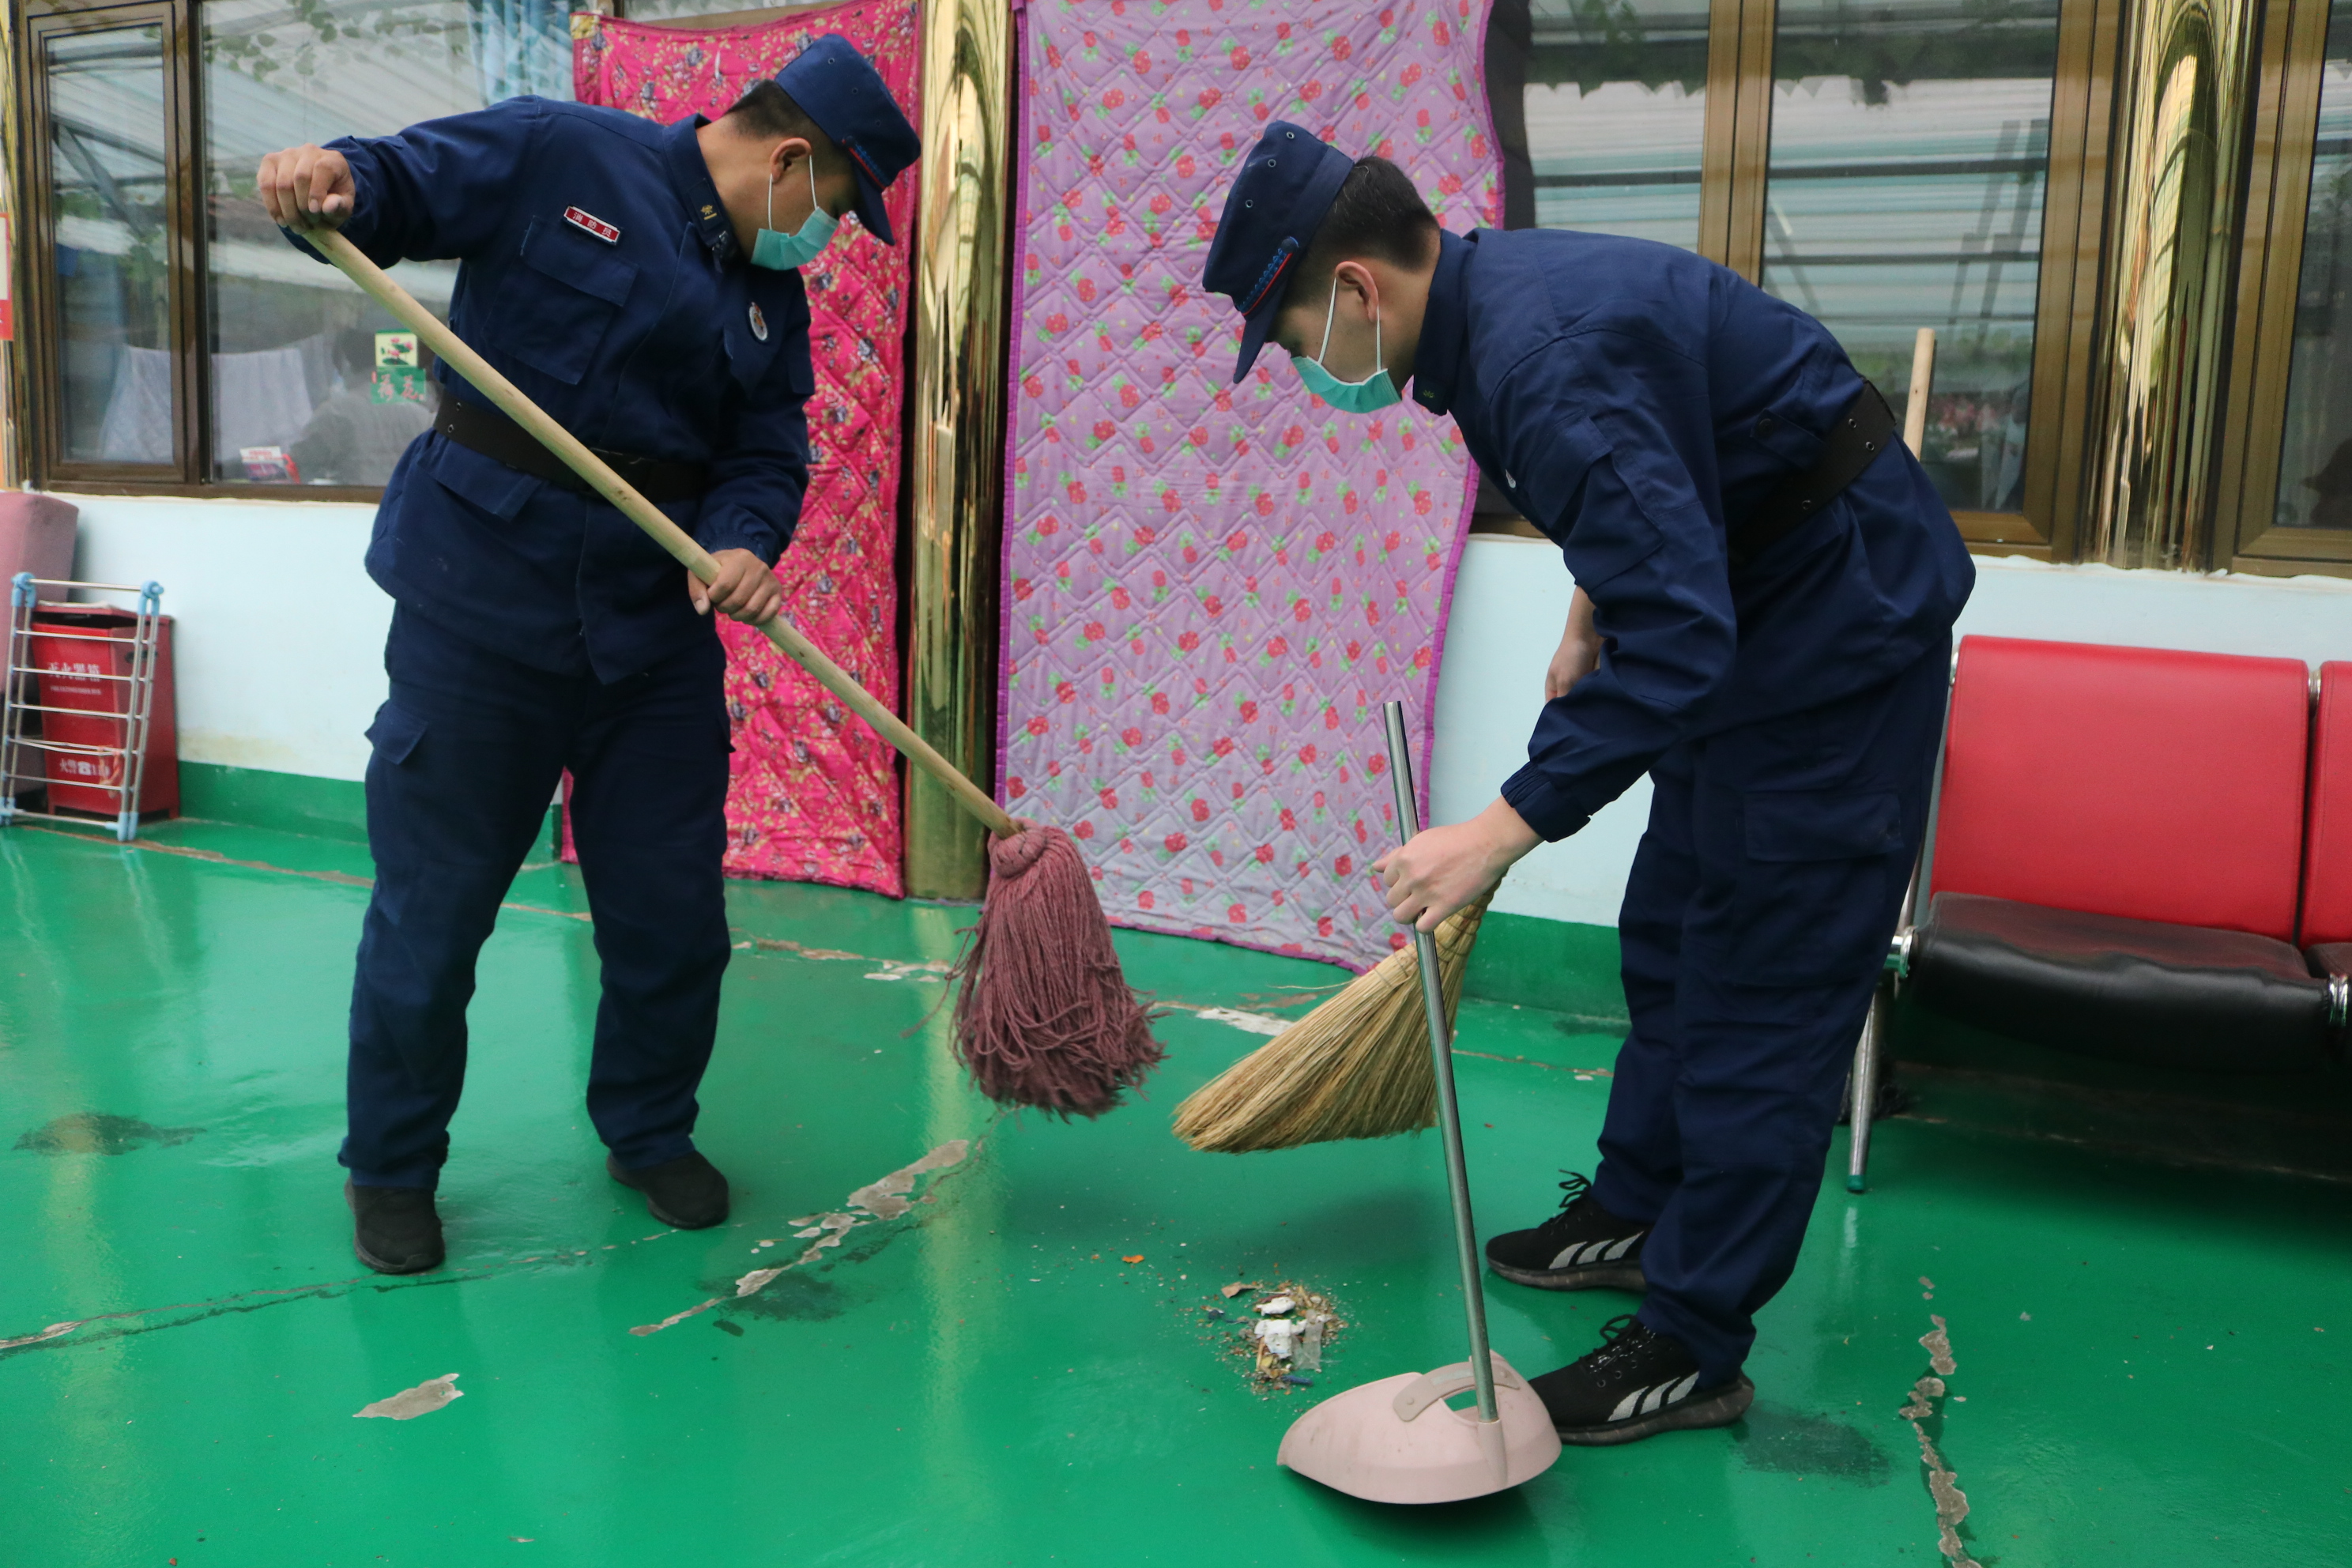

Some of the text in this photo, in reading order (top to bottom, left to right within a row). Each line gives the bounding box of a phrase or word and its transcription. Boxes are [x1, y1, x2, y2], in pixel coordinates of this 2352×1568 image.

[573, 212, 612, 237] 消防员
[47, 662, 100, 682] 灭火器箱
